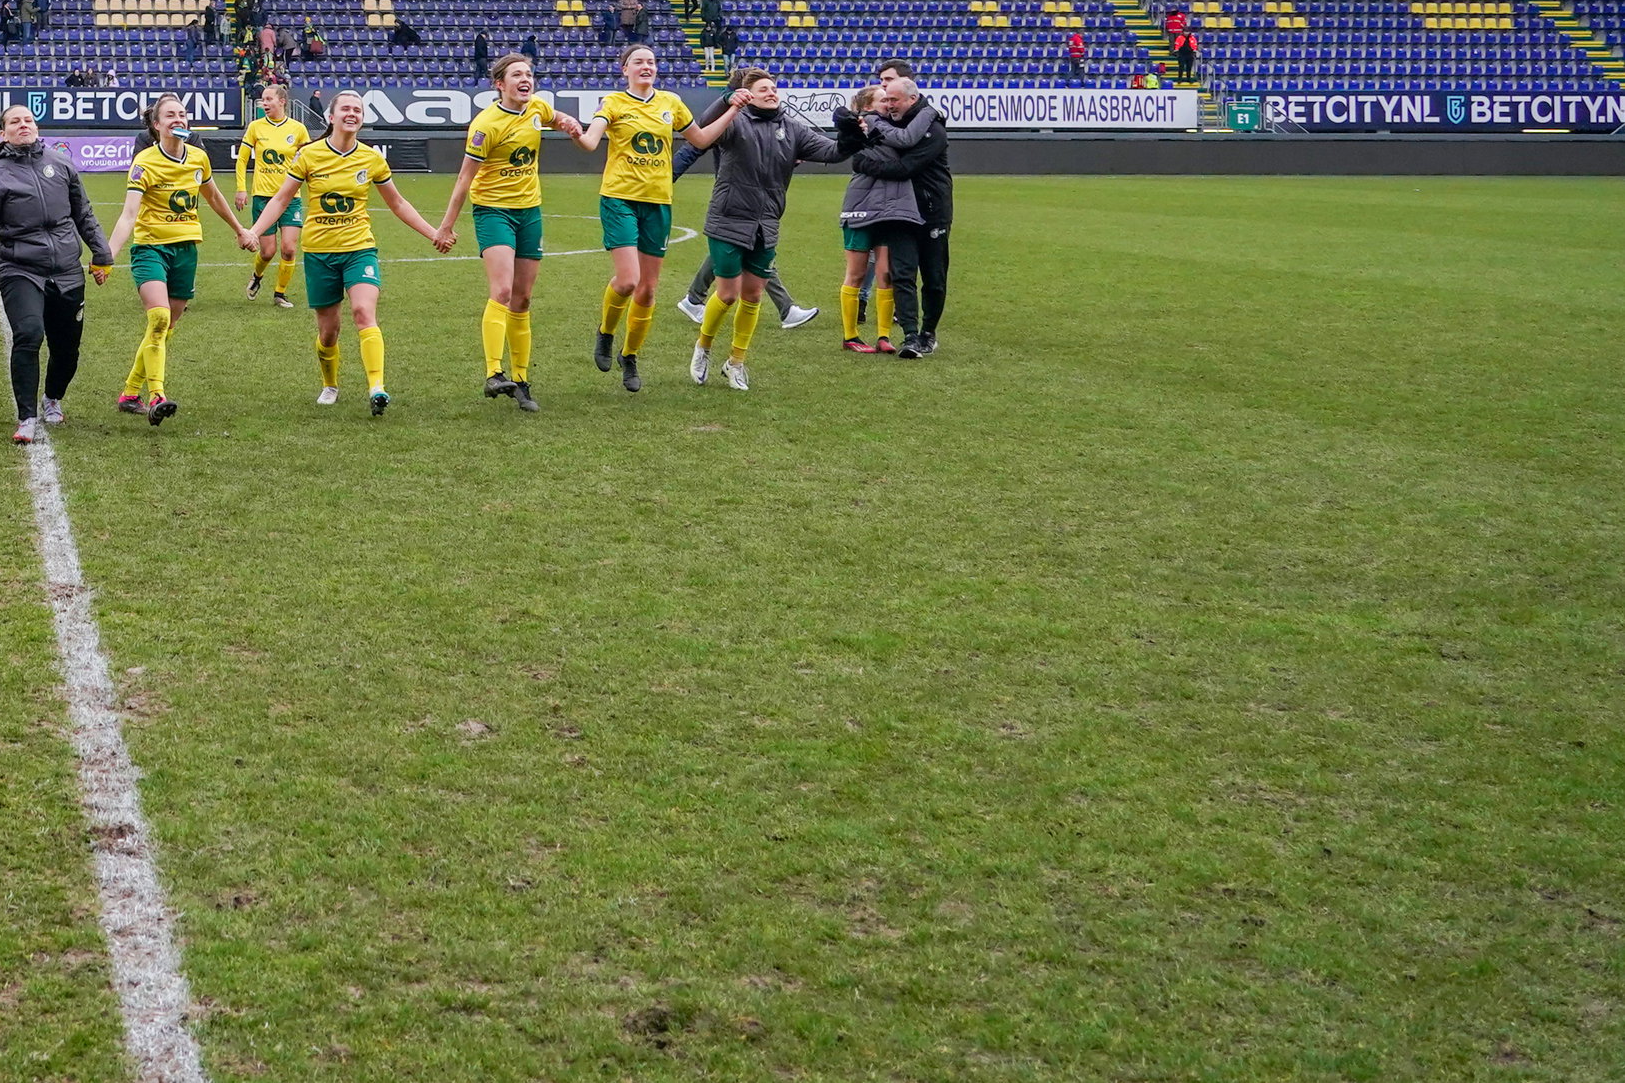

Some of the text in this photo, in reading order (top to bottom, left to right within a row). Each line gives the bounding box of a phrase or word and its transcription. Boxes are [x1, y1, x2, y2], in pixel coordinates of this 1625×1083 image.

[940, 94, 1058, 122] SCHOENMODE
[1063, 95, 1177, 123] MAASBRACHT
[1237, 113, 1250, 124] E1
[1264, 95, 1440, 123] BETCITY.NL
